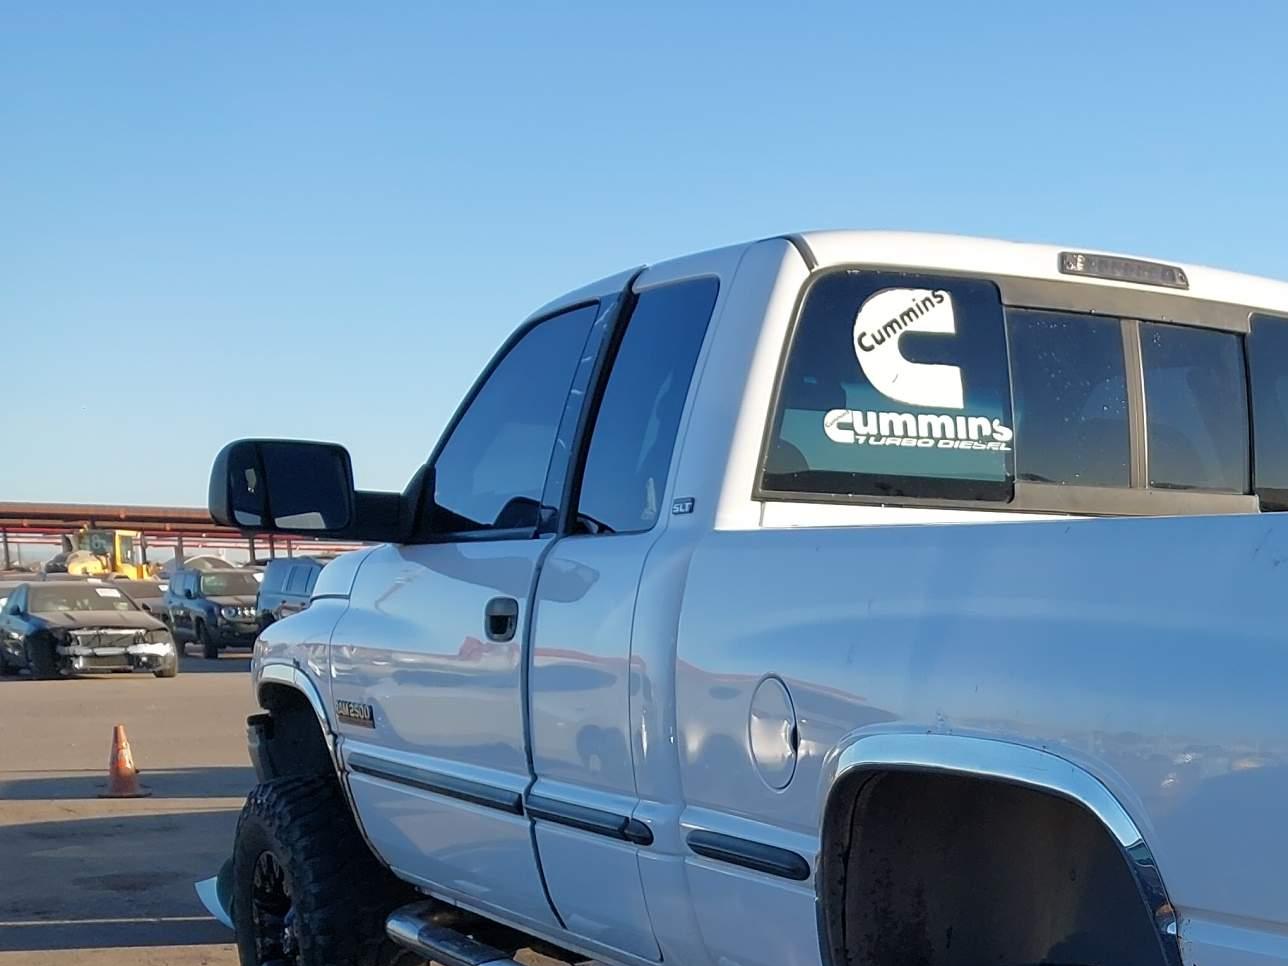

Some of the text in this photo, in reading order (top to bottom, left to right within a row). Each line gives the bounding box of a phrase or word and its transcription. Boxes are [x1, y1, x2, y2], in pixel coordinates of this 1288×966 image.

[857, 289, 945, 353] Cummins
[856, 435, 1012, 451] TURBO DIESEL
[672, 502, 693, 513] SLT
